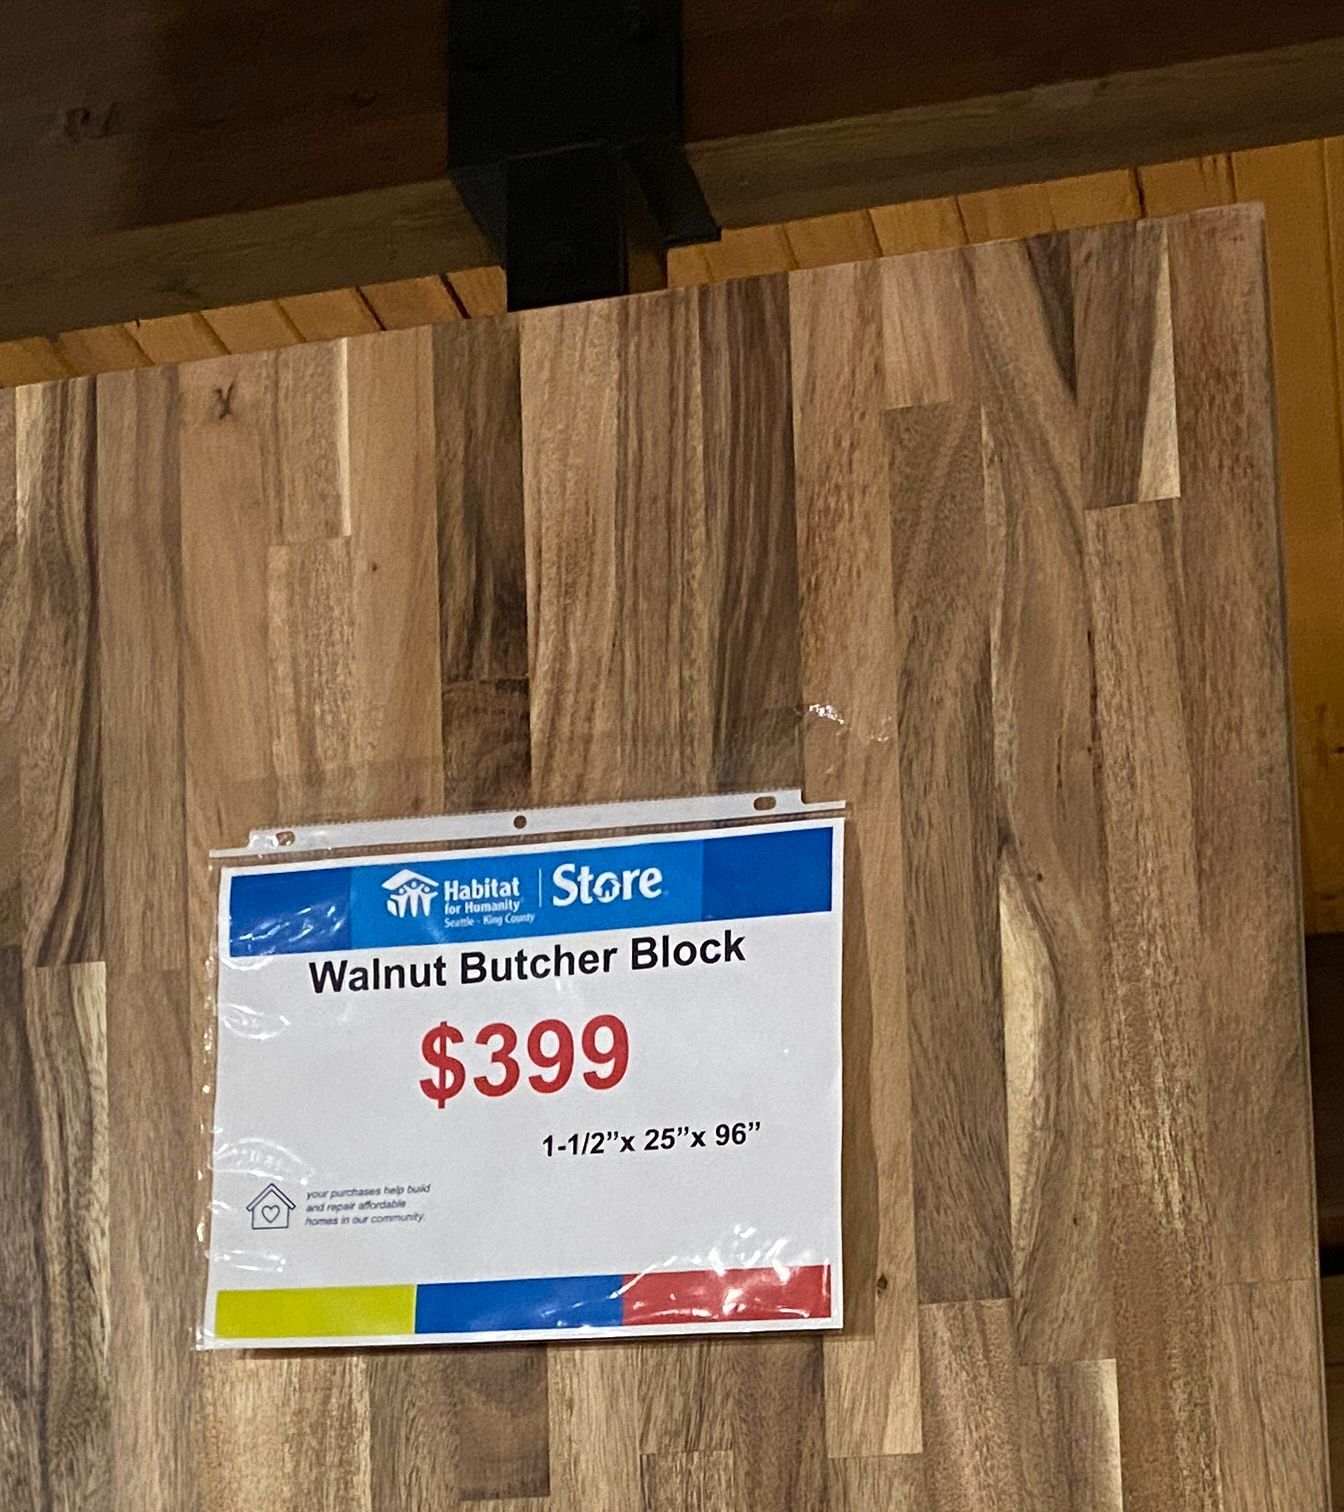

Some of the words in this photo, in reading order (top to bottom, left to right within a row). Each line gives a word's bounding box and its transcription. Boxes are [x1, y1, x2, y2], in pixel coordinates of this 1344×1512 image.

[444, 877, 520, 901] Habitat
[552, 863, 663, 907] Store
[444, 901, 460, 915] for
[464, 898, 520, 914] Humanity
[483, 914, 503, 926] King
[308, 954, 447, 995] Walnut
[459, 942, 618, 986] Butcher
[631, 929, 746, 970] Block
[418, 1014, 631, 1110] $399
[330, 1188, 381, 1199] purchases
[383, 1186, 404, 1196] help
